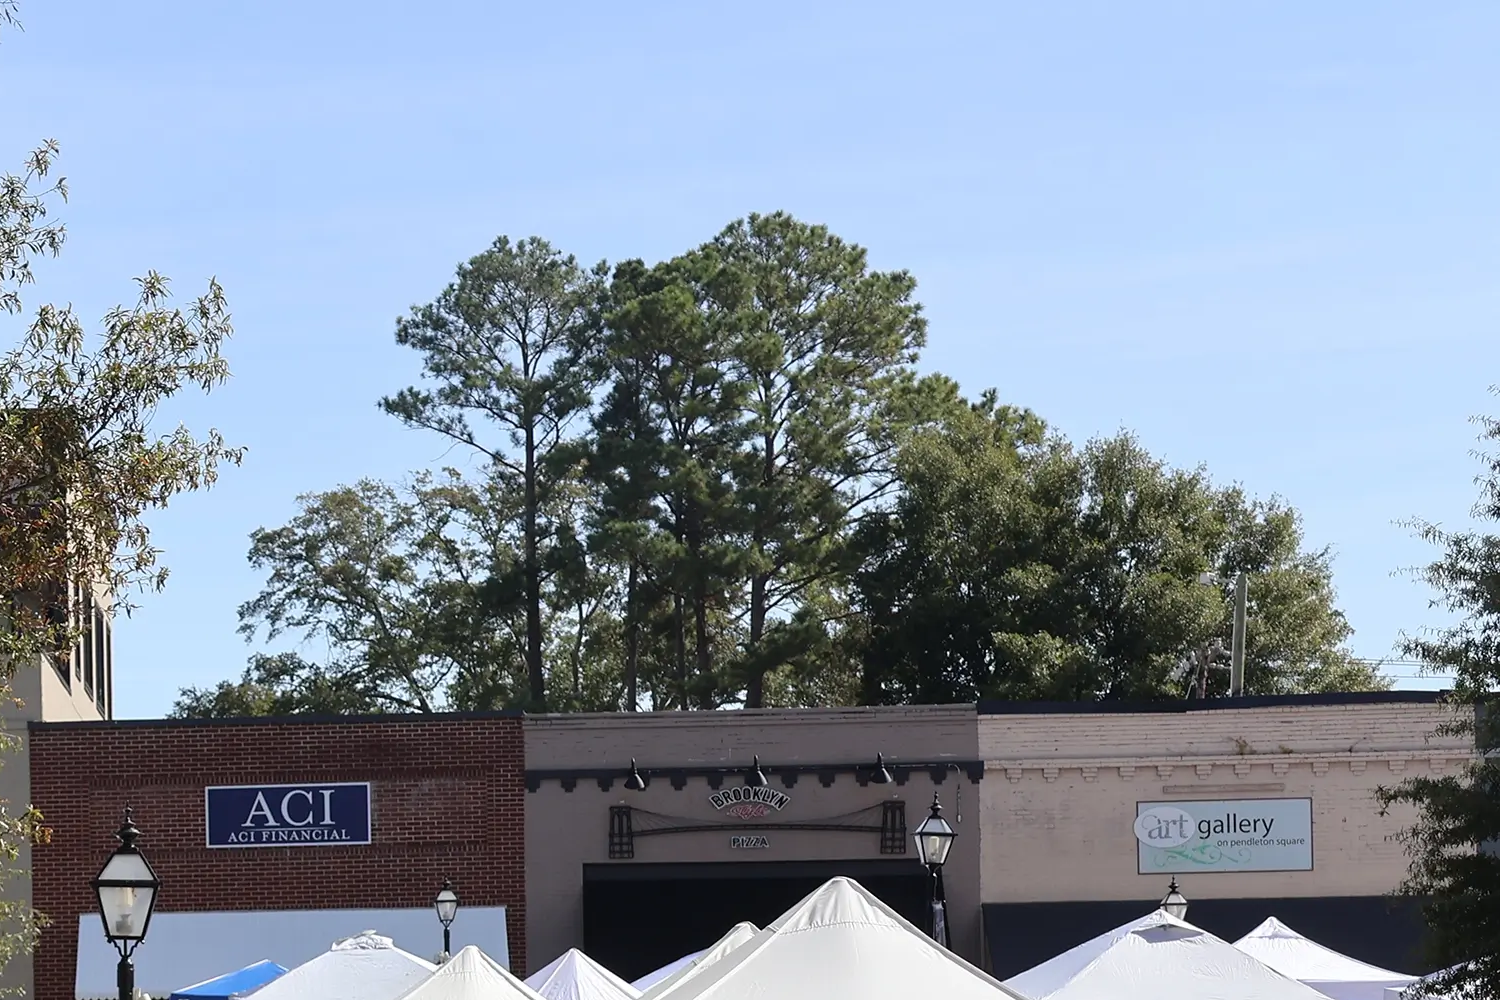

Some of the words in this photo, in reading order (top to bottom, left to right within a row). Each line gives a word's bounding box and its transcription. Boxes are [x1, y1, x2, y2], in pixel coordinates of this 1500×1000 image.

[241, 789, 336, 827] ACI
[709, 786, 791, 811] BROOKLYN
[228, 831, 255, 842] ACI
[262, 829, 350, 841] FINANCIAL
[1142, 814, 1189, 840] art
[1198, 813, 1274, 839] gallery
[731, 836, 769, 848] PIZZA
[1217, 839, 1228, 847] on
[1230, 837, 1274, 849] pendleton
[1276, 837, 1305, 847] square
